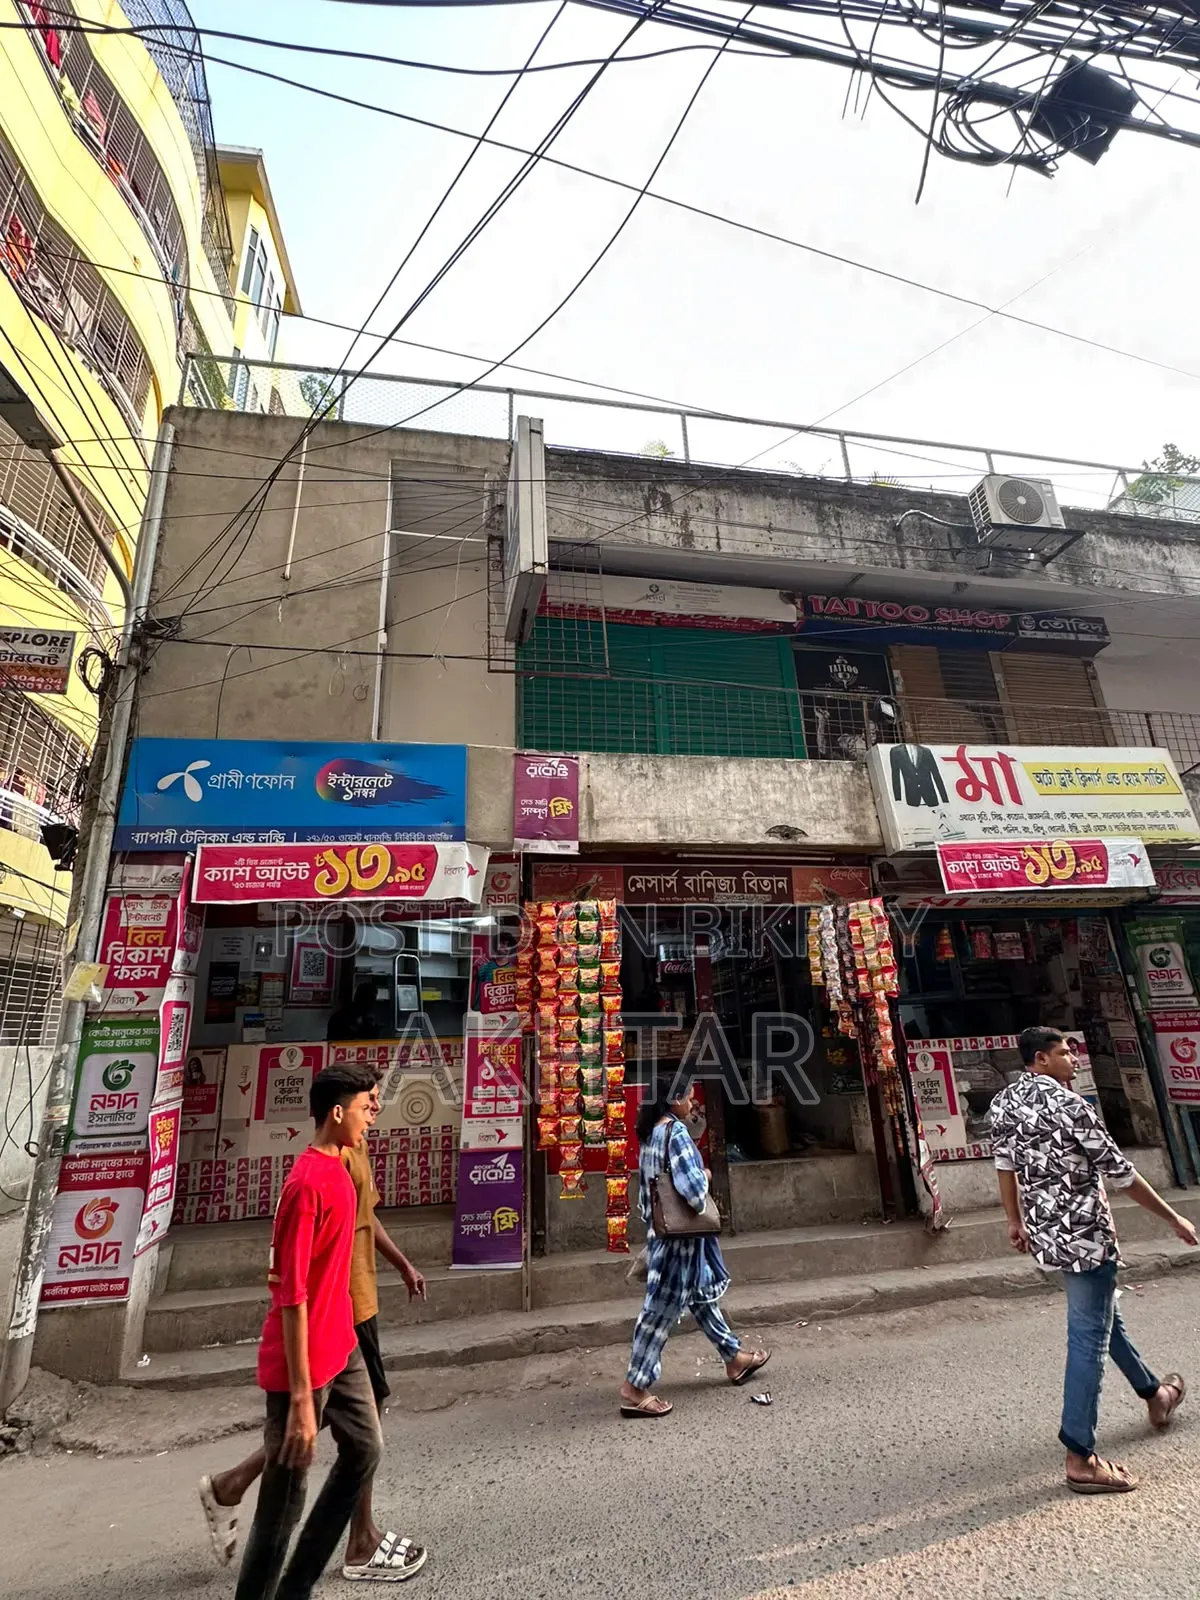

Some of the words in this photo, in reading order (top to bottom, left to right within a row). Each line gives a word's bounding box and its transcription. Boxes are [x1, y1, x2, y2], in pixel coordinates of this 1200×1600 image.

[808, 594, 929, 623] TATTOO
[934, 606, 1011, 629] SHOP
[828, 665, 859, 675] TATTOO
[207, 768, 296, 791] গ্রামীণফোন
[328, 772, 394, 788] ইন্টারনেটে
[940, 744, 1024, 807] মা
[1032, 769, 1056, 787] অটো
[180, 829, 229, 844] টেলিকম
[204, 866, 252, 882] ক্যাশ
[256, 862, 311, 881] আউট
[947, 860, 979, 874] ক্যাশ
[981, 856, 1020, 872] আউট
[628, 869, 680, 894] মেসার্স
[683, 870, 738, 894] বানিজ্য
[741, 870, 788, 895] বিতান
[127, 925, 167, 946] বিল
[106, 941, 171, 964] বিকাশ
[113, 965, 162, 981] করুন
[494, 970, 516, 983] বিল
[1147, 969, 1182, 981] নগদ
[88, 1026, 111, 1038] কোটি
[112, 1027, 141, 1039] মানুষের
[93, 1040, 114, 1048] সবার
[115, 1039, 133, 1047] হাতে
[134, 1038, 152, 1047] হাতে
[478, 1041, 517, 1057] ডিপিএস
[274, 1078, 286, 1088] পে
[286, 1075, 305, 1087] বিল
[926, 1078, 941, 1088] বিল
[279, 1087, 300, 1095] করুন
[90, 1093, 139, 1112] নগদ
[88, 1110, 137, 1124] ইসলামিক
[65, 1158, 91, 1171] কোটি
[91, 1157, 123, 1171] মানুষের
[124, 1157, 144, 1167] সাথে
[71, 1172, 94, 1182] সবার
[94, 1171, 114, 1181] হাতে
[115, 1170, 135, 1180] হাতে
[469, 1163, 516, 1185] রকেট
[460, 1221, 492, 1238] সম্পূর্ণ
[58, 1241, 122, 1268] নগদ
